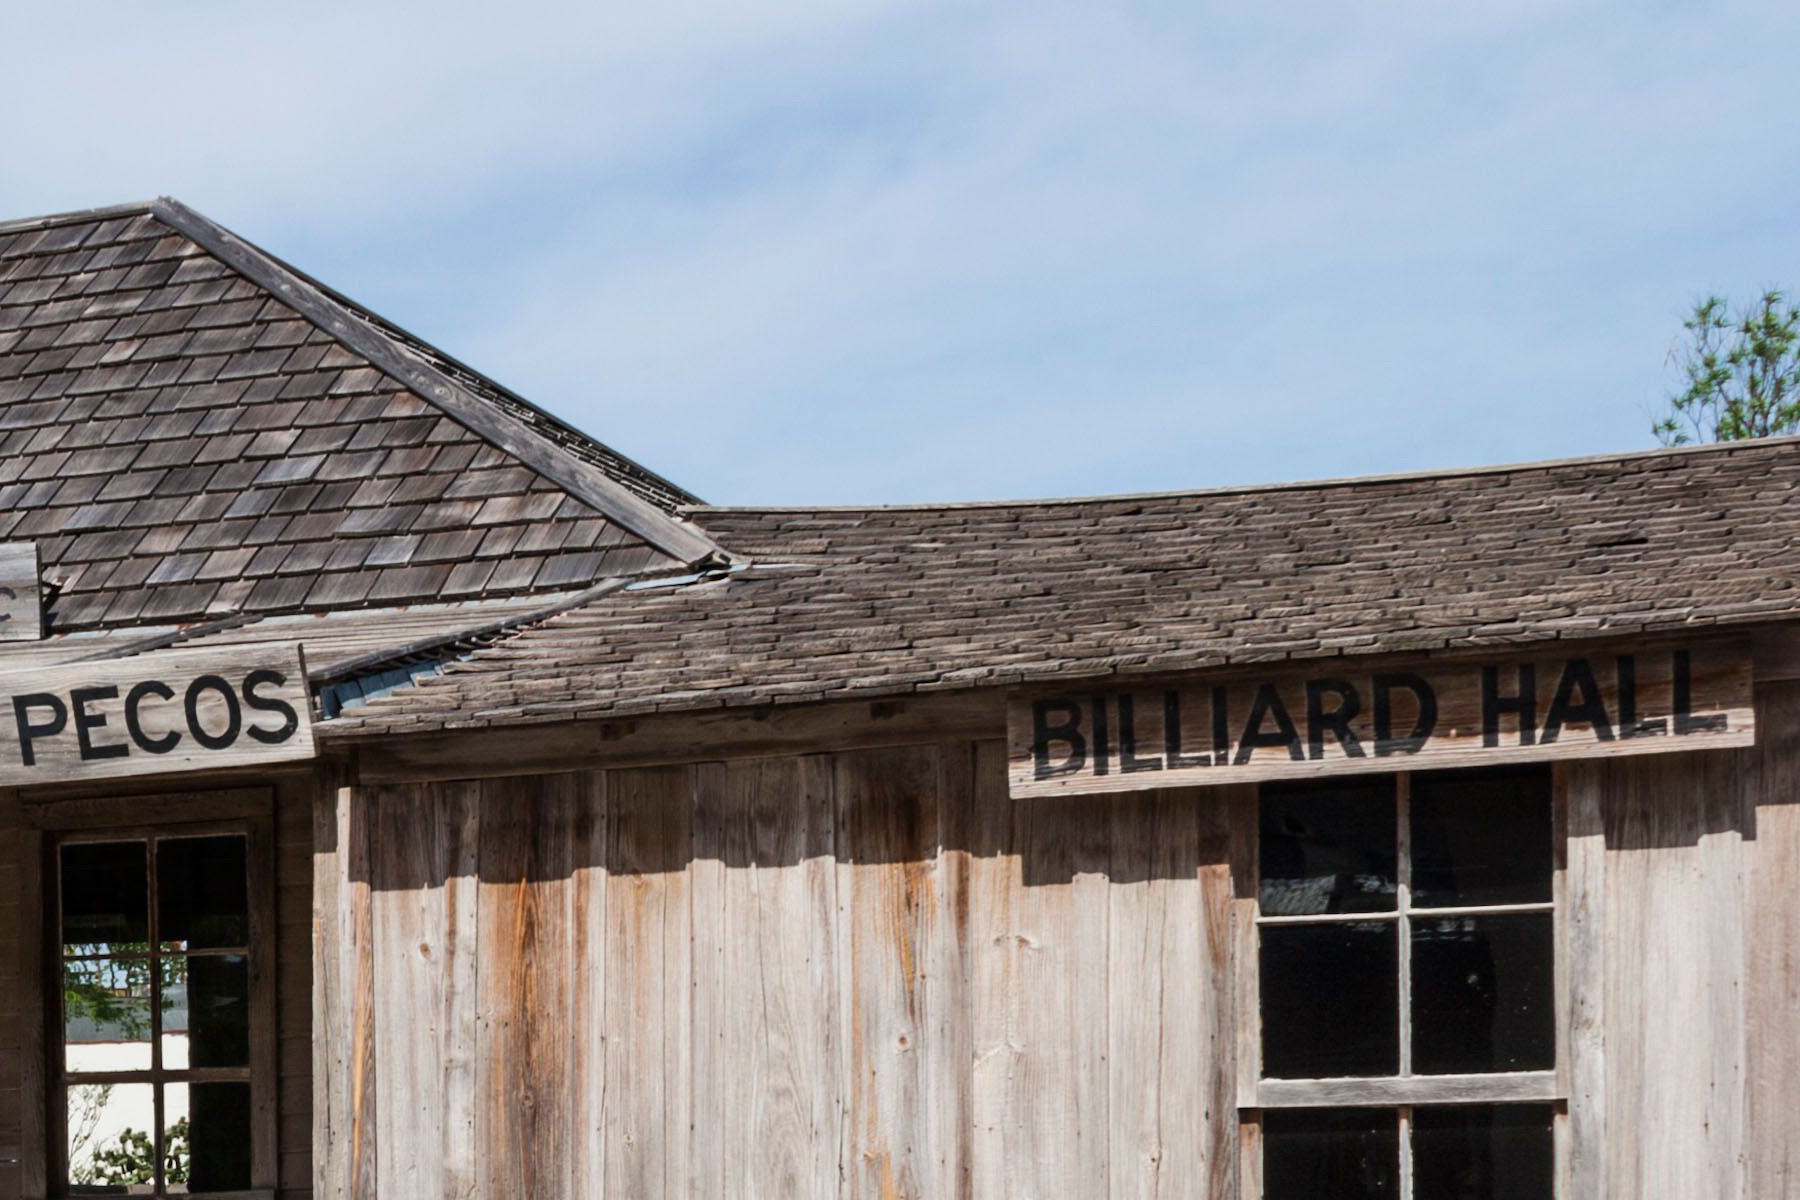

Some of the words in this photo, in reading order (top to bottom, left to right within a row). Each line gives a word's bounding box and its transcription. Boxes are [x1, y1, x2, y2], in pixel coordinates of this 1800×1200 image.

[13, 669, 299, 767] PECOS
[1031, 674, 1438, 781] BILLIARD
[1480, 652, 1727, 748] HALL
